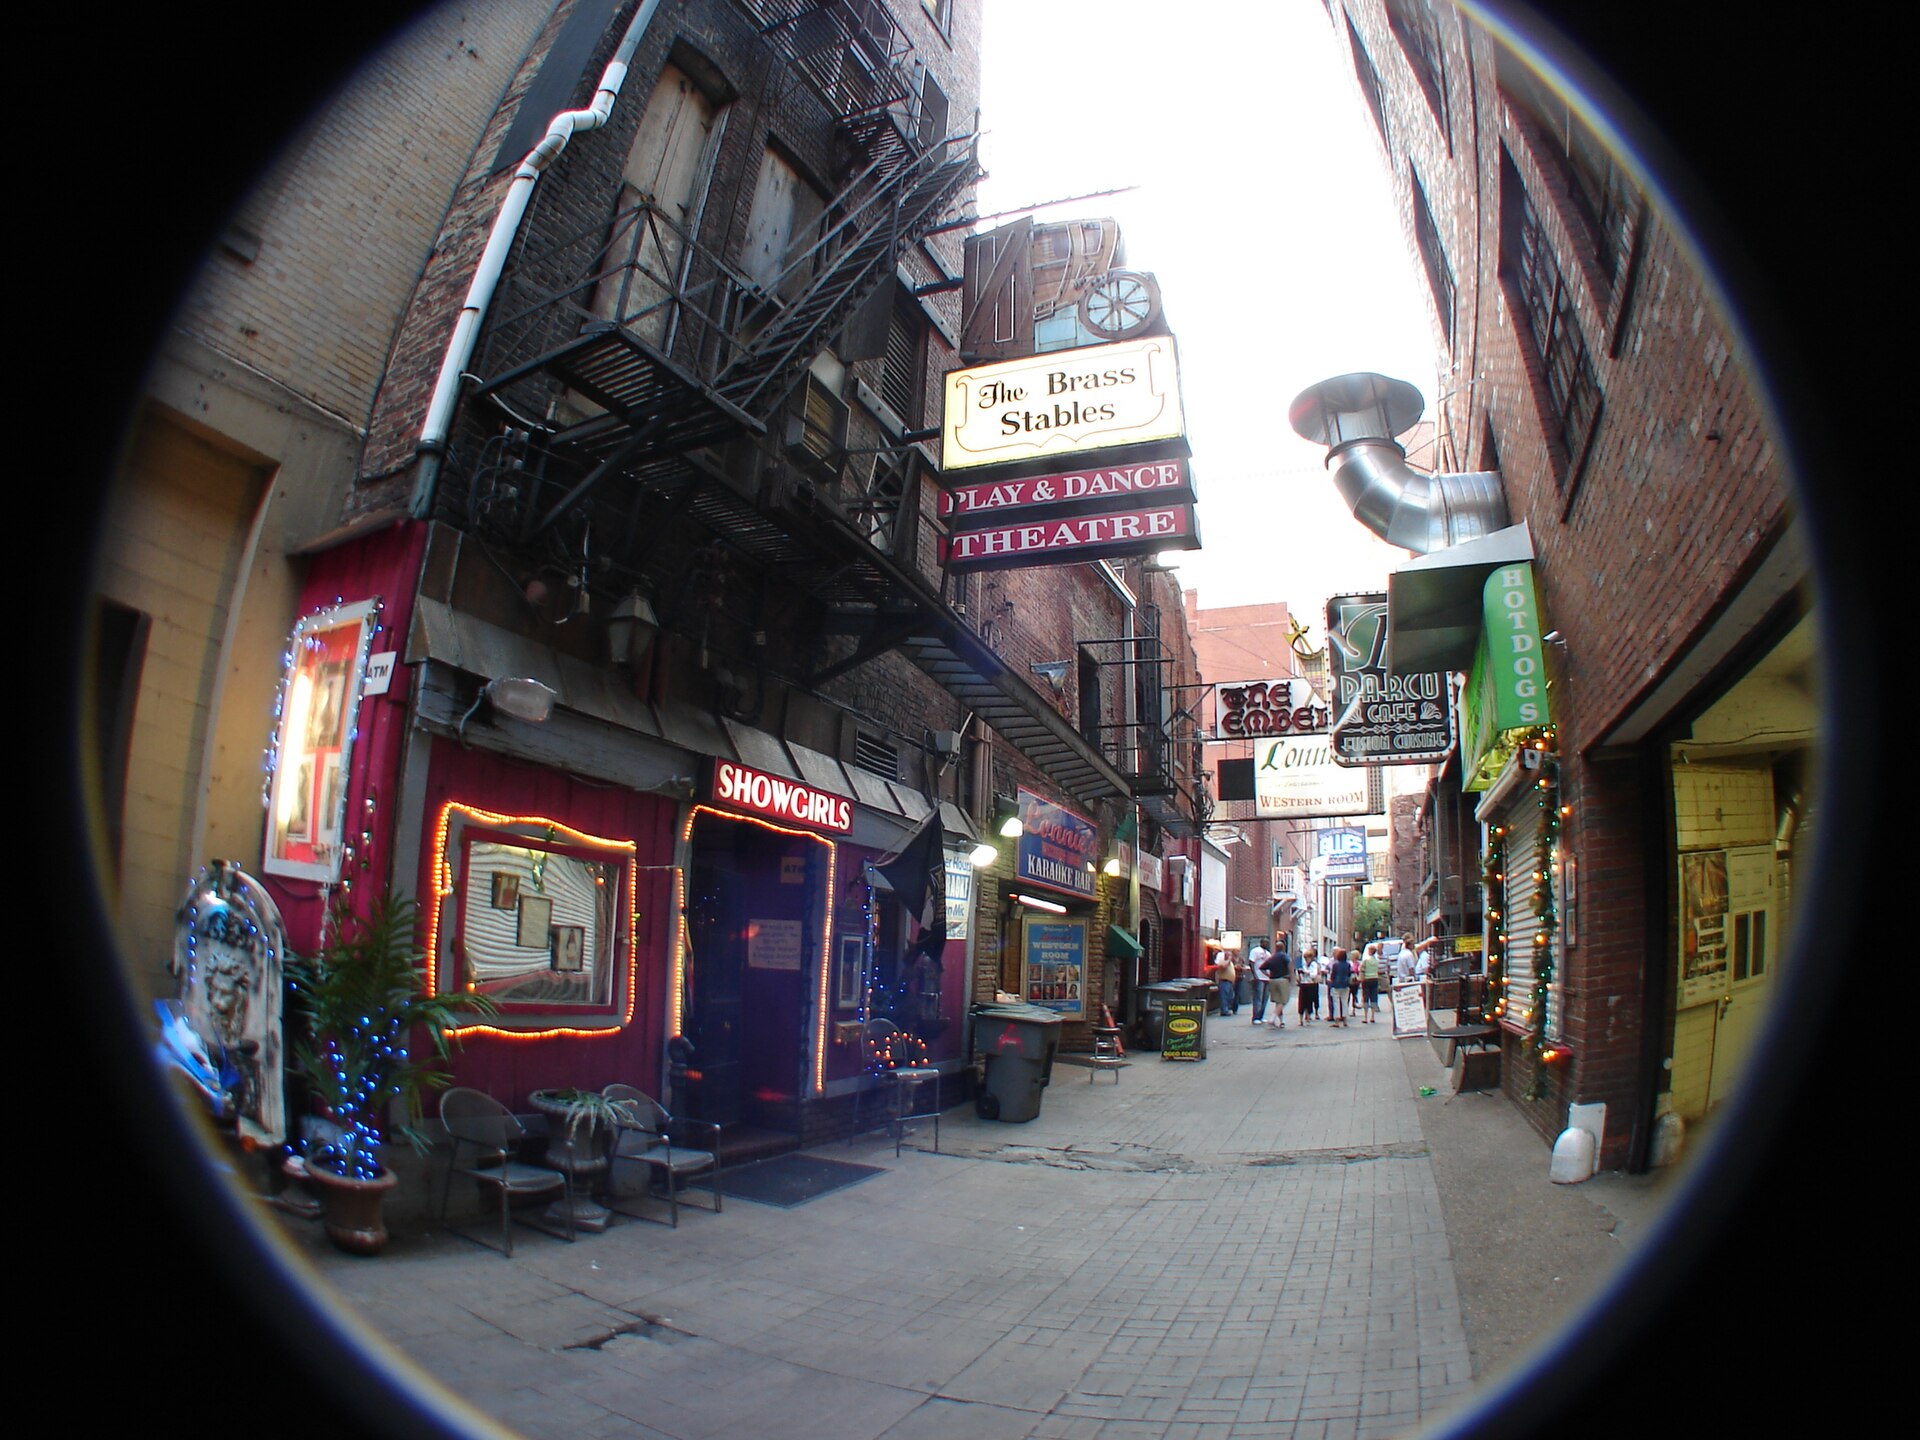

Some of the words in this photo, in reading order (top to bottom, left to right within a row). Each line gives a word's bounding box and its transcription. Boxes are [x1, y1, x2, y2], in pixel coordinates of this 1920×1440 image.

[978, 381, 1028, 409] The
[1047, 365, 1136, 397] Brass
[1001, 401, 1117, 437] Stables
[946, 485, 1025, 513] PLAY
[1031, 479, 1056, 502] &
[1063, 463, 1179, 496] DANCE
[952, 510, 1177, 558] THEATRE
[367, 664, 389, 679] ATM
[1340, 672, 1440, 705] PARCO
[1221, 681, 1292, 710] THE
[1367, 702, 1416, 723] CAFE
[1341, 735, 1390, 752] FUSION
[1393, 732, 1446, 749] CUISINE
[718, 763, 851, 831] SHOWGIRLS
[1260, 795, 1322, 808] WESTERN
[1328, 791, 1364, 805] ROOM
[1028, 854, 1073, 886] KARAOKE
[1075, 870, 1091, 891] BAR
